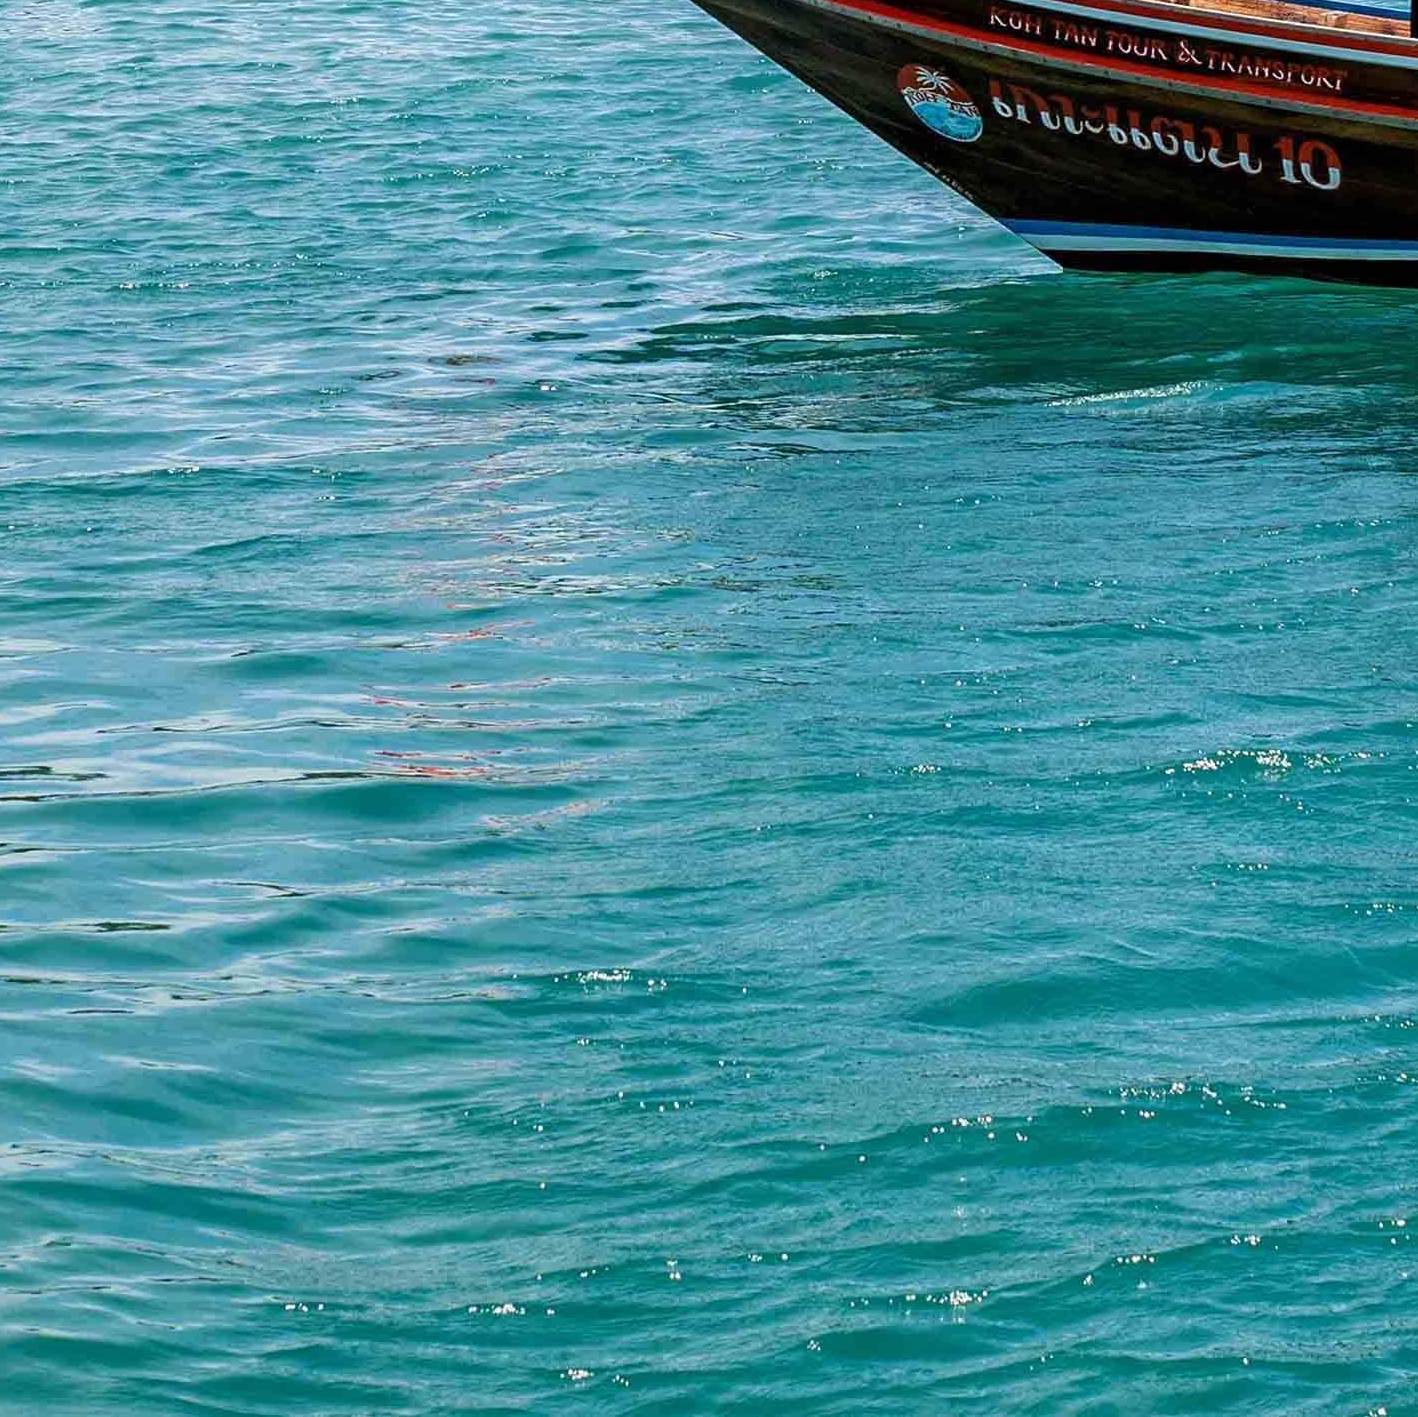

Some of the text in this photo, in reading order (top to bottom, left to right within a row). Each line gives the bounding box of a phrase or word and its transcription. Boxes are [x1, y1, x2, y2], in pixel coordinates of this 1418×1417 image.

[990, 6, 1349, 91] KOH TAN TOUR & TRANSPORT
[1274, 136, 1342, 190] 10
